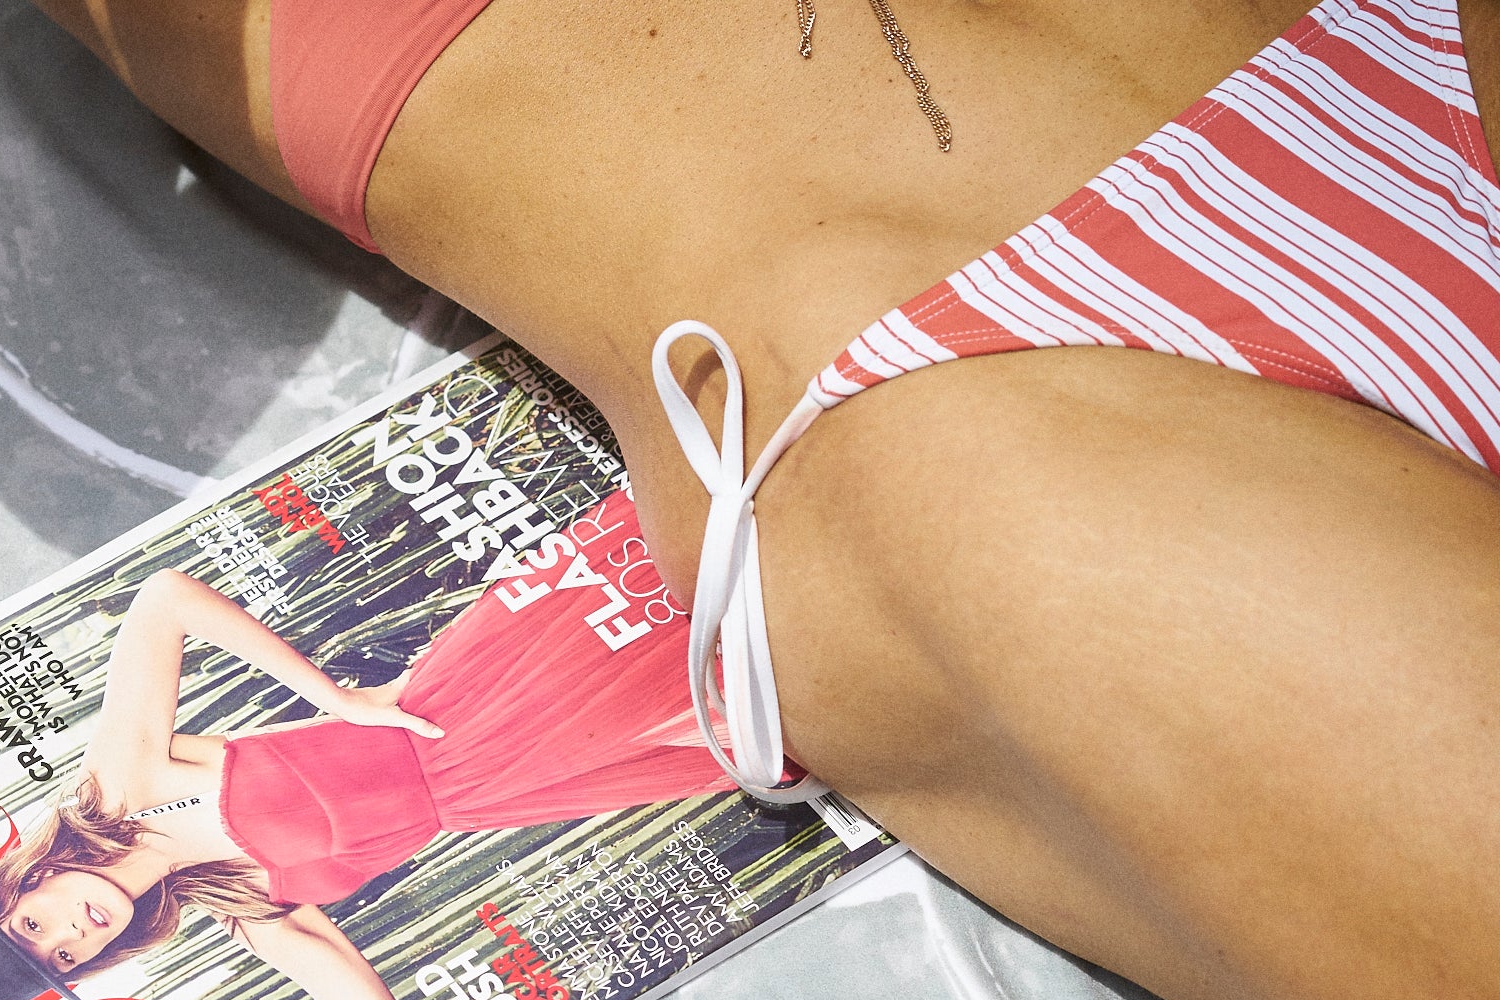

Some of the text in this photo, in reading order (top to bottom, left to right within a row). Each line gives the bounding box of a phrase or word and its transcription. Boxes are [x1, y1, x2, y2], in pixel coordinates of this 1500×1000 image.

[304, 454, 358, 509] YEARS
[438, 370, 624, 546] REWIND
[185, 522, 237, 574] DIOR'S
[216, 504, 288, 579] DESIGNER
[253, 487, 307, 532] ANDY
[275, 474, 345, 554] WARHOL
[286, 461, 384, 563] THE VOGUE
[350, 415, 548, 613] FASHION
[391, 392, 652, 651] FLASHBACK
[199, 512, 296, 615] FIRST FEMALE
[4, 663, 18, 672] I
[9, 673, 53, 718] WHAT
[25, 661, 55, 690] IT'S
[39, 651, 53, 660] I
[47, 660, 83, 700] WHO
[48, 716, 69, 734] IS
[673, 821, 760, 912] JEFF BRIDGES
[846, 823, 862, 835] 03
[538, 847, 654, 978] NATALIE PORTMAN
[570, 854, 672, 968] NICOLE KIDMAN
[583, 838, 689, 953] JOEL EDGERTON
[625, 852, 707, 946] RUTH NEGGA
[659, 860, 725, 936] DEV PATEL
[663, 839, 743, 922] AMY ADAMS
[496, 860, 619, 999] MICHELLE WILLIAMS
[513, 910, 563, 962] STONE
[535, 874, 635, 987] CASEY AFFLECK
